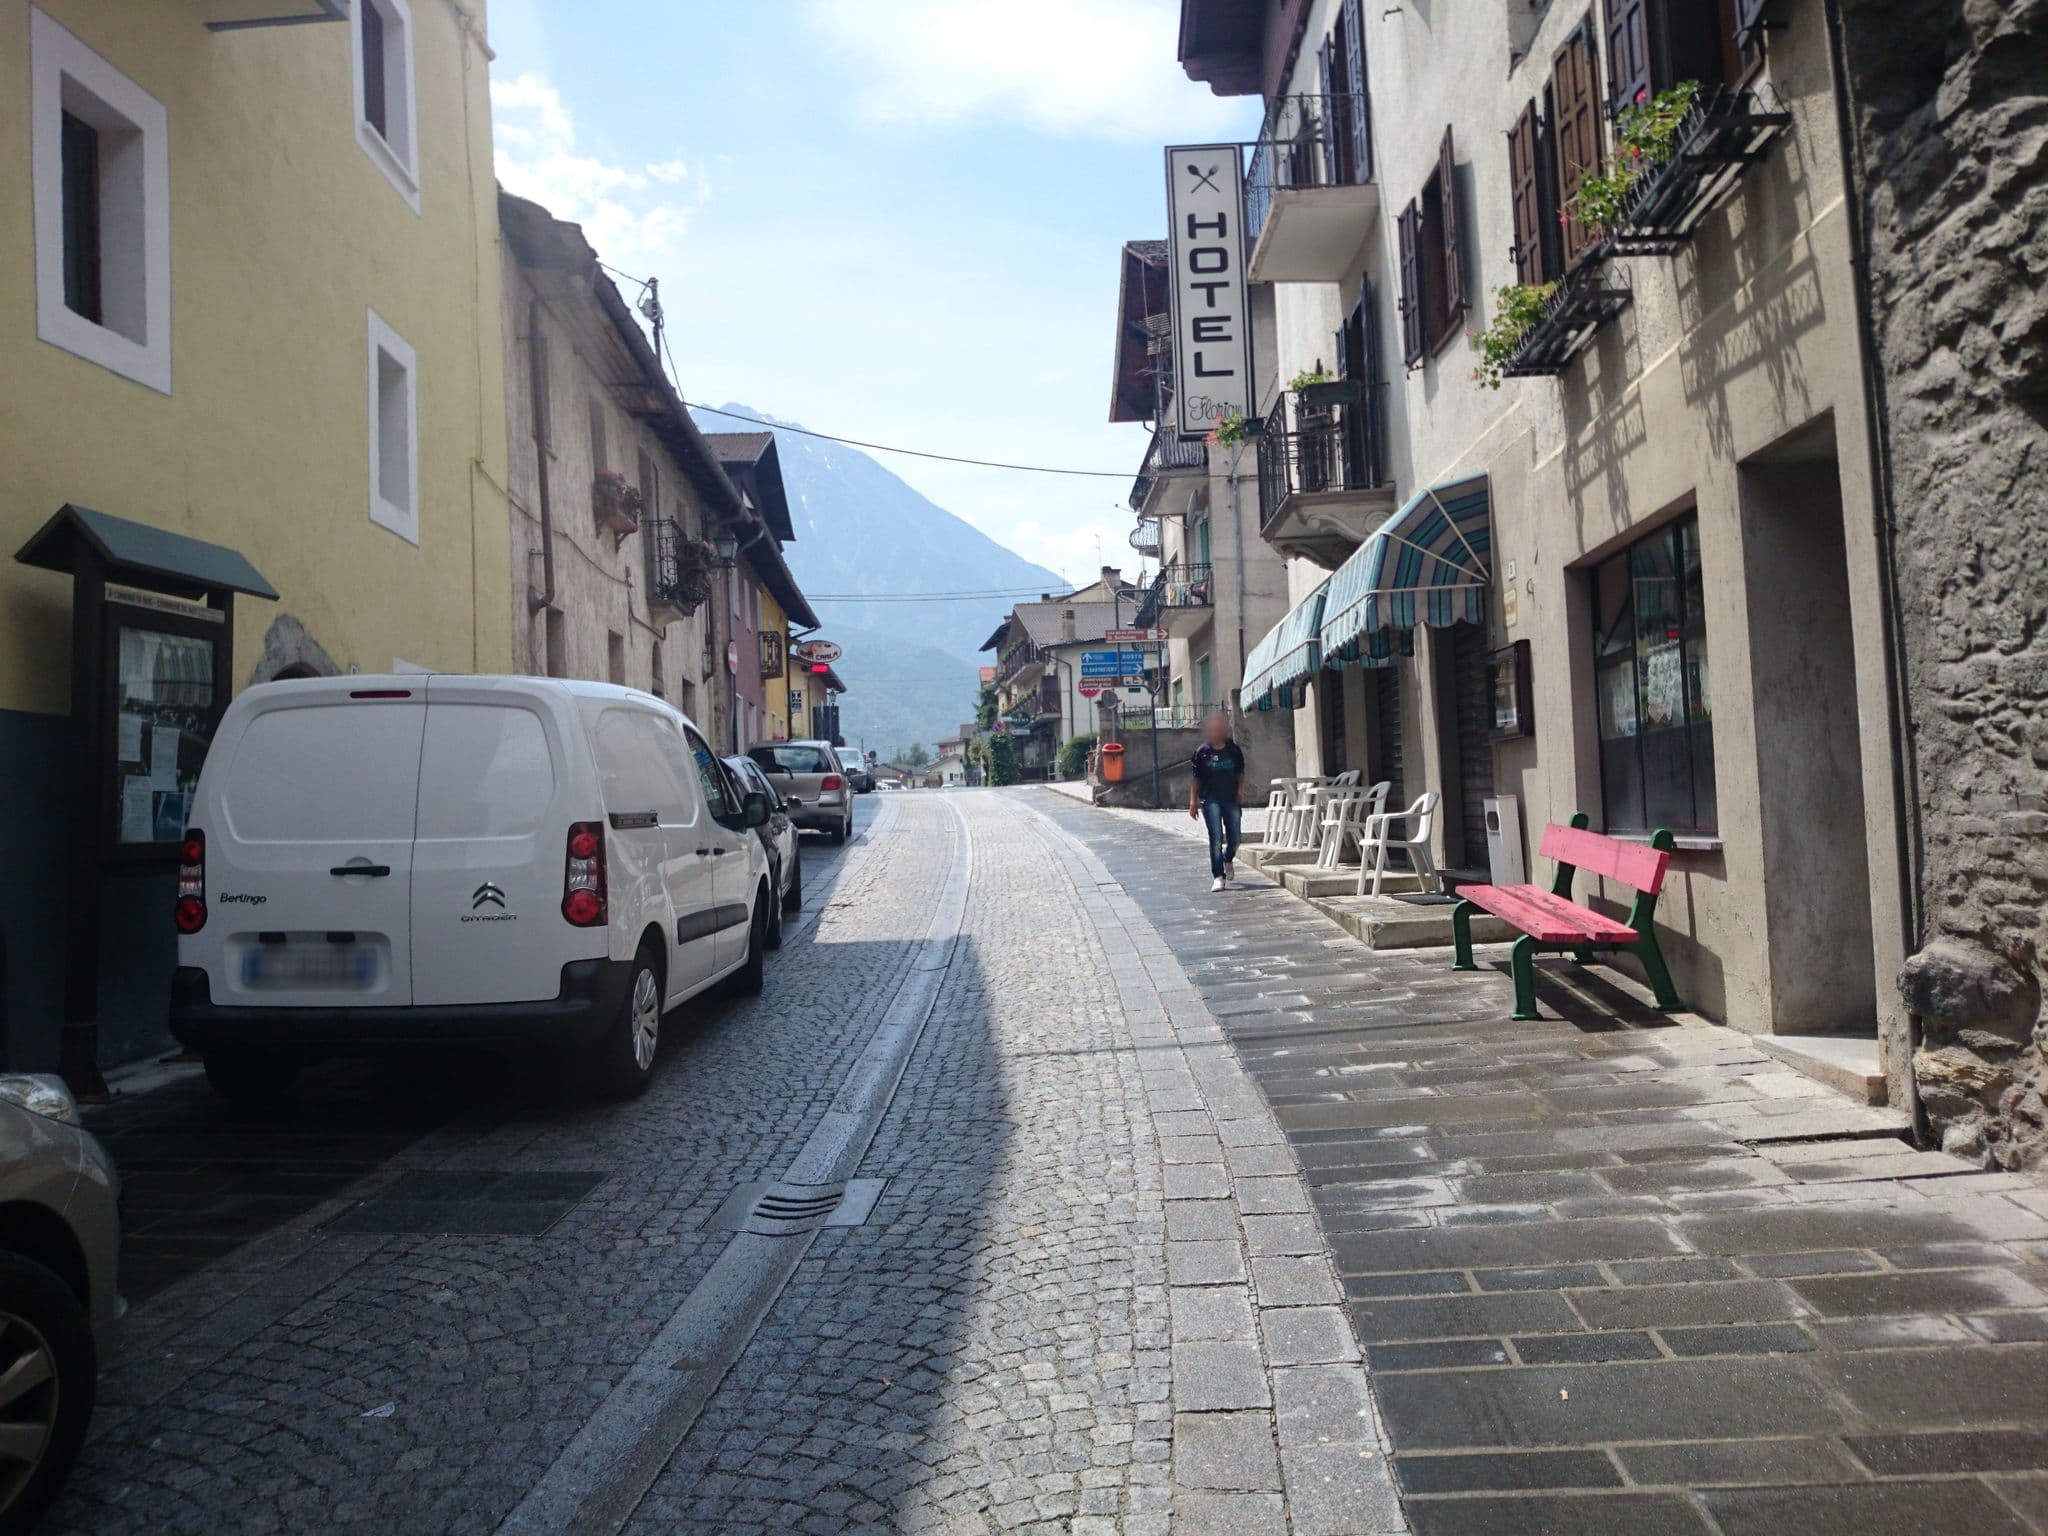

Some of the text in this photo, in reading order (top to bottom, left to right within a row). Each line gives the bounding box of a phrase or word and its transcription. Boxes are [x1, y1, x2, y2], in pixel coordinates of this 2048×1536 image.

[1187, 212, 1234, 378] HOTEL
[1187, 395, 1242, 421] Florian
[219, 892, 267, 906] Berlingo
